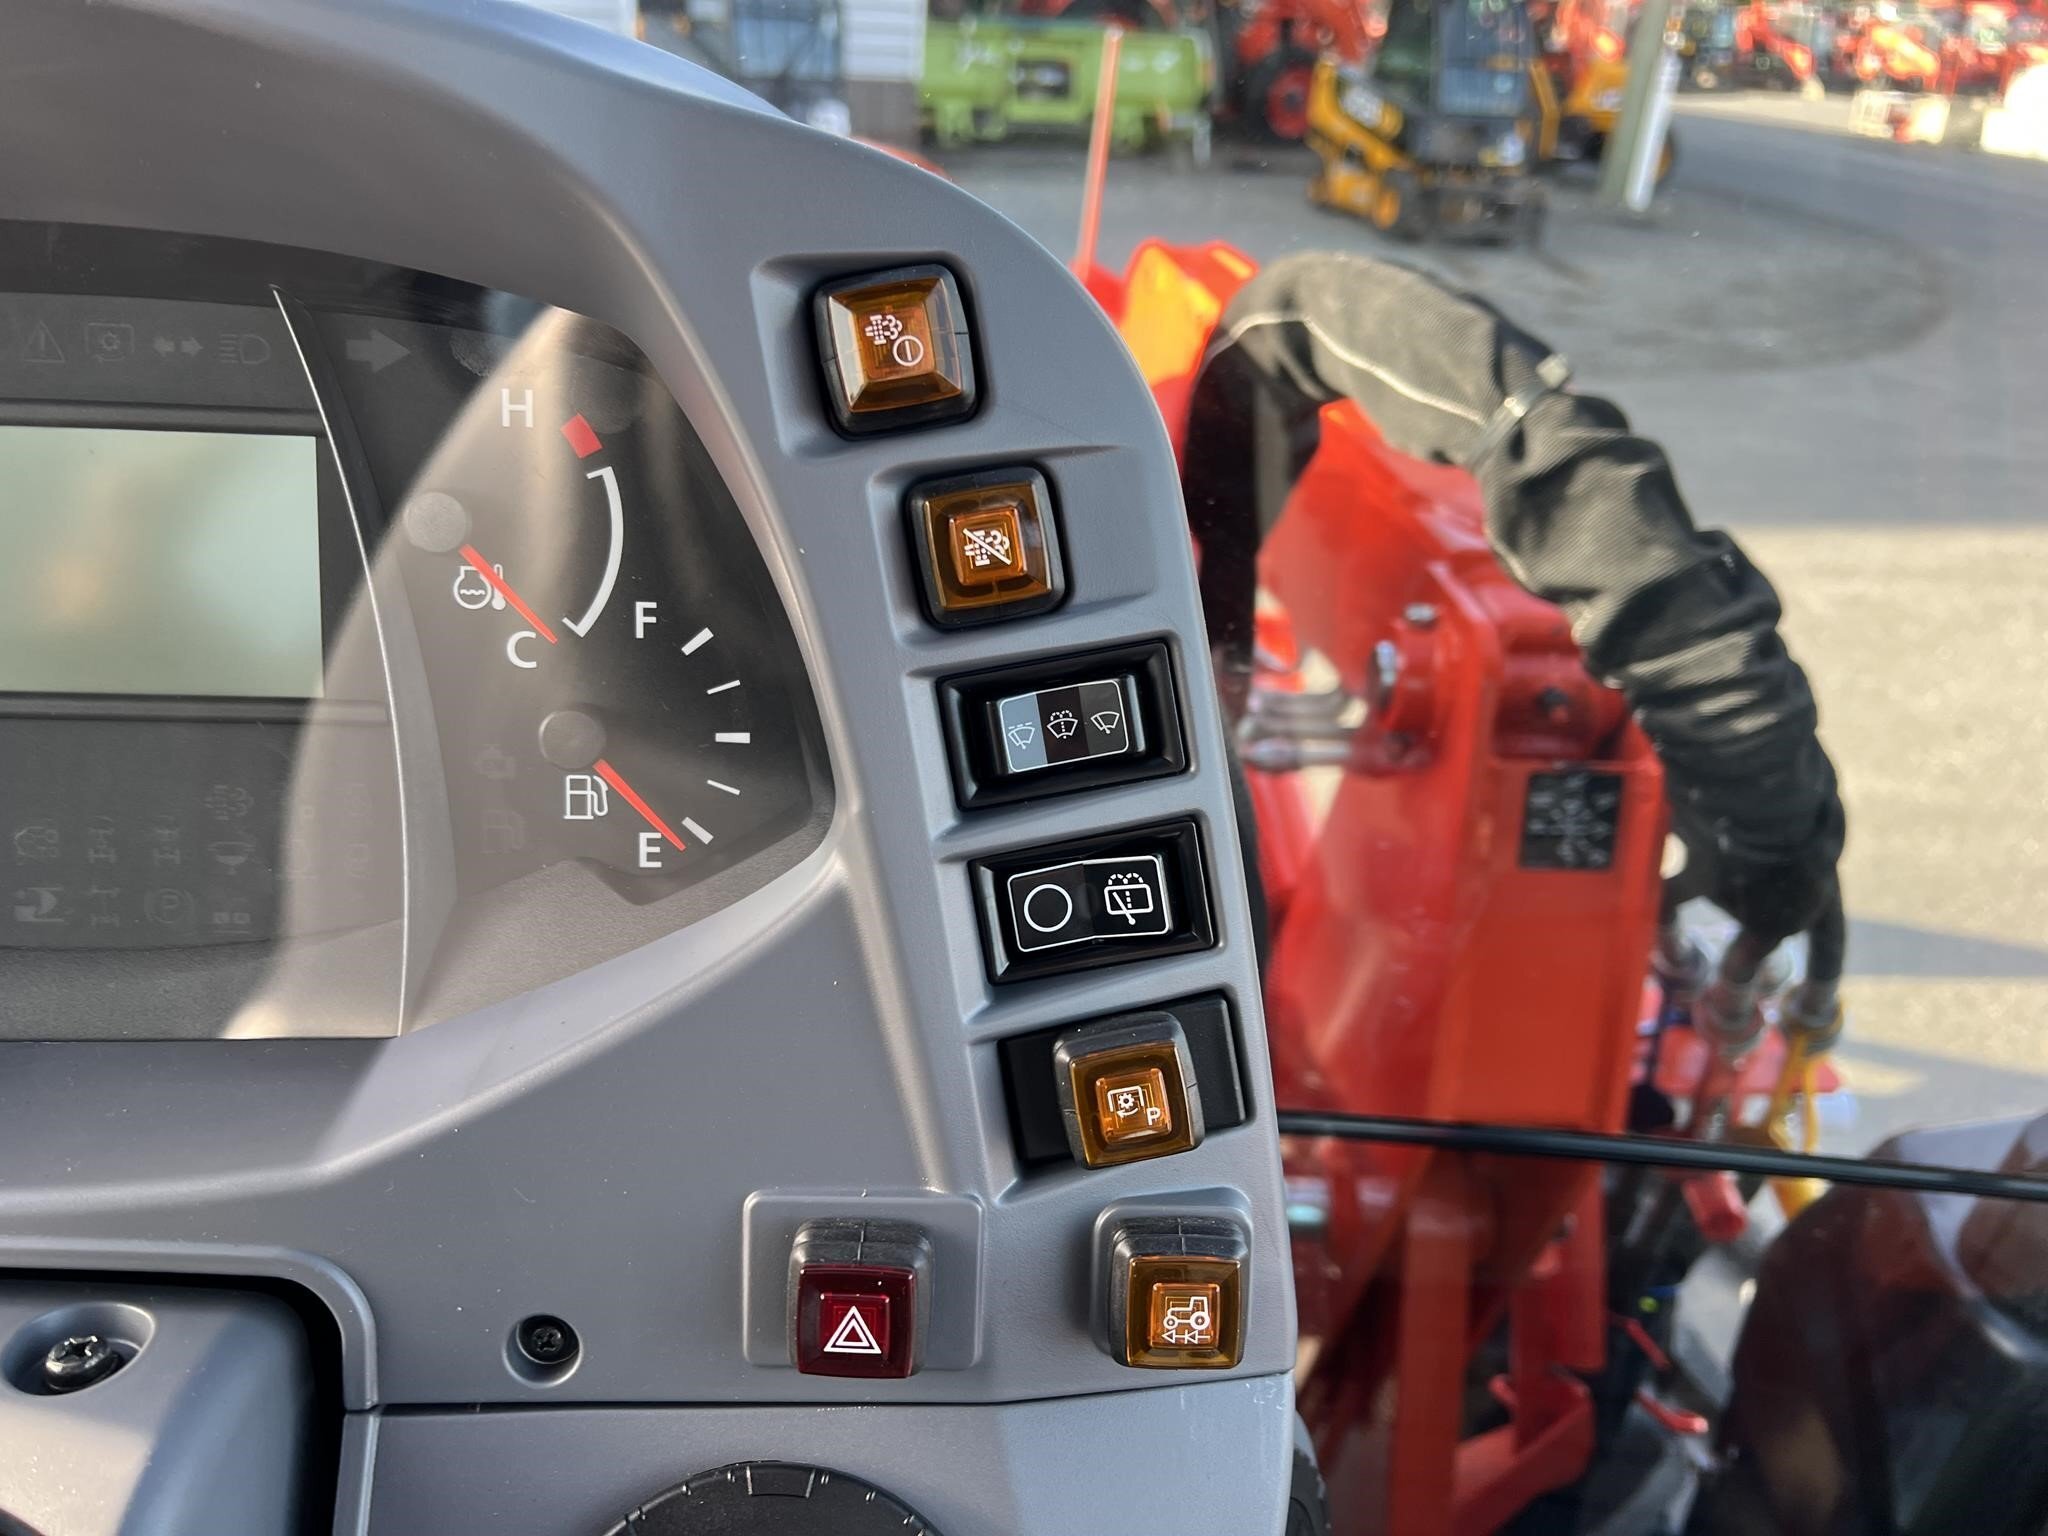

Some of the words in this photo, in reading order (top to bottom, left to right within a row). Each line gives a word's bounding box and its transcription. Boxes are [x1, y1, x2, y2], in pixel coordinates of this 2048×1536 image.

[501, 388, 534, 428] H
[635, 601, 658, 639] F
[506, 630, 538, 669] C
[638, 832, 662, 868] E
[1146, 1106, 1161, 1126] P
